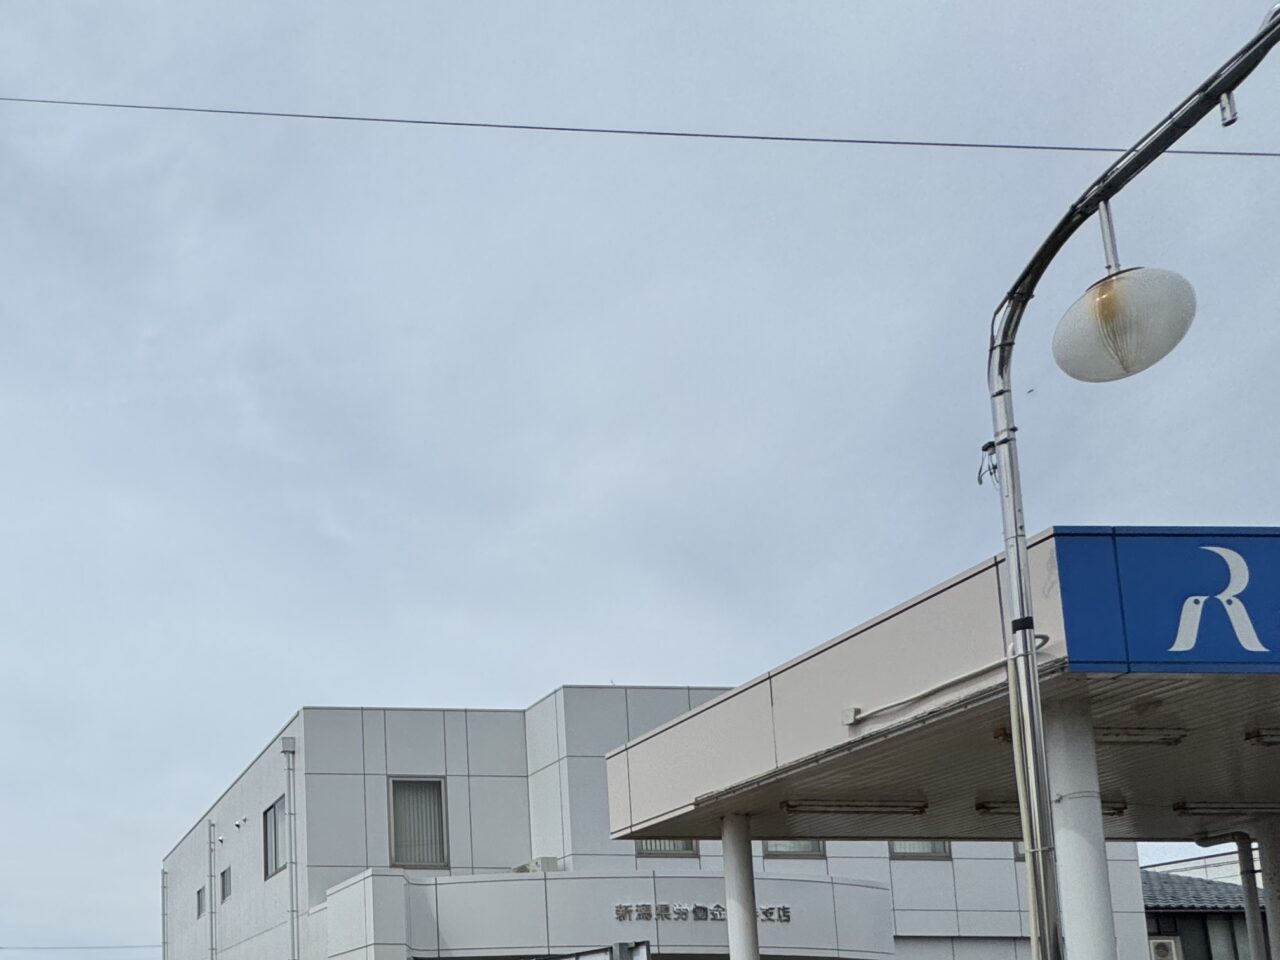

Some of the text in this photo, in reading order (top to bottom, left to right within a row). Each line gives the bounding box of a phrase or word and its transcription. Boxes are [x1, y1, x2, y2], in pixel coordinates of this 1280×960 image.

[615, 903, 791, 923] 新潟県労働金支店
